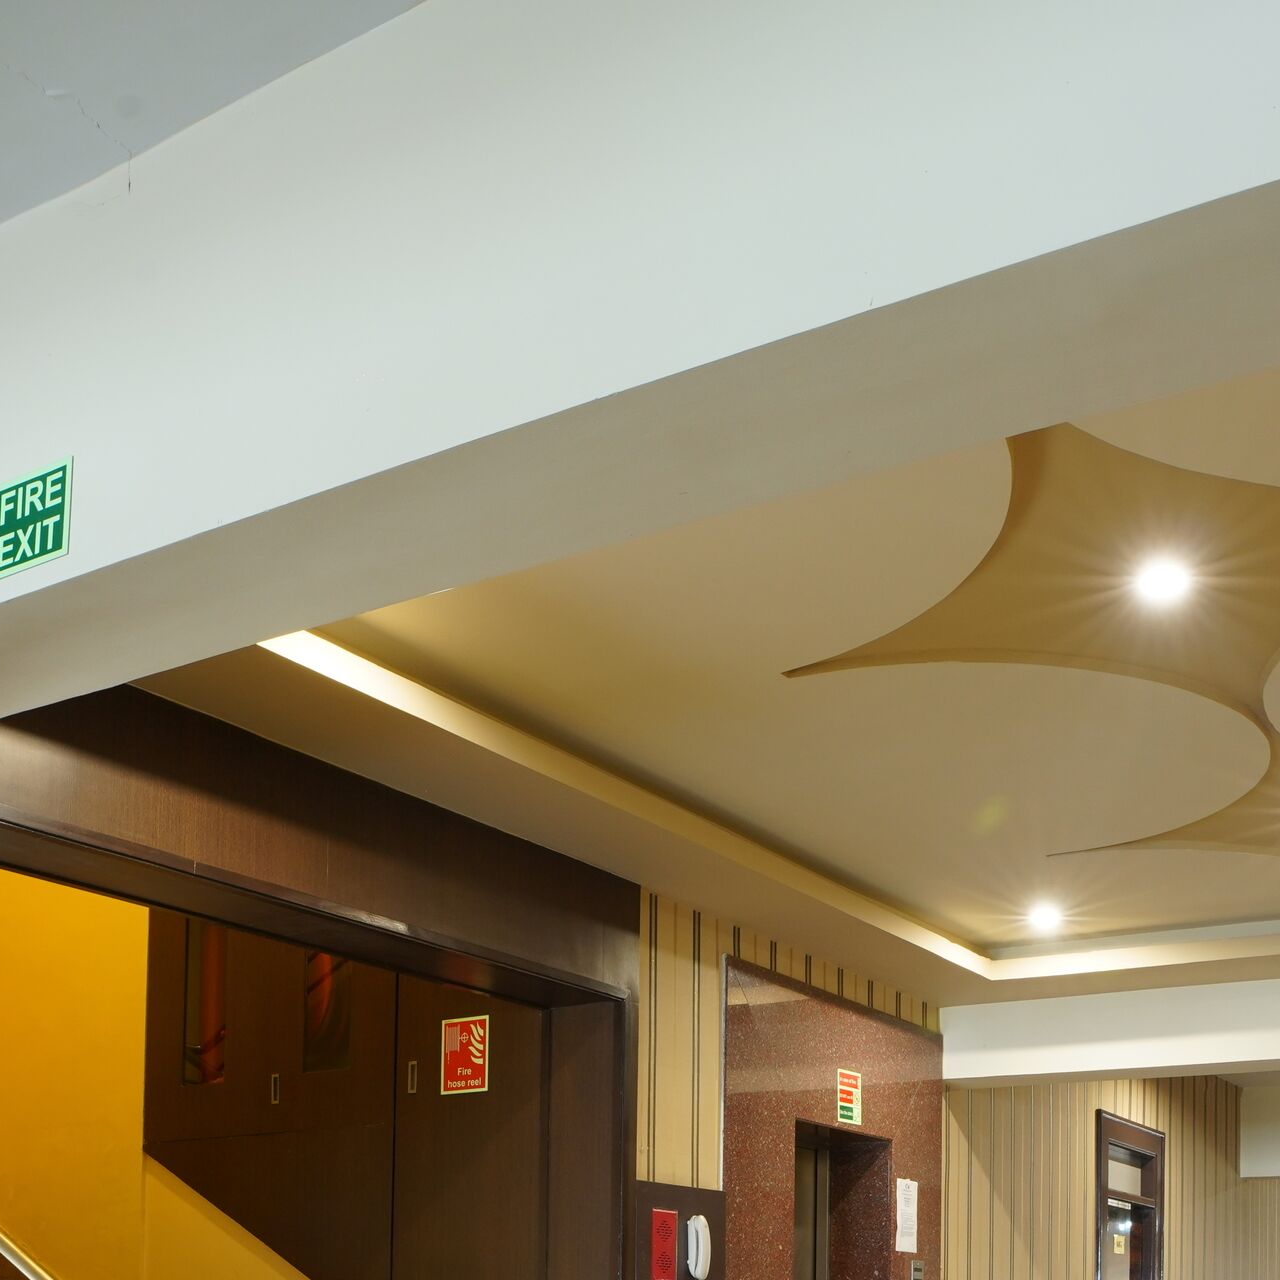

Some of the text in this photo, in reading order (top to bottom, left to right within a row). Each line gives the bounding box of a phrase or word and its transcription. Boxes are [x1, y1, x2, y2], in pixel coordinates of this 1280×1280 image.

[0, 470, 63, 527] FIRE
[457, 1067, 472, 1077] Fire
[447, 1077, 482, 1089] hose reel
